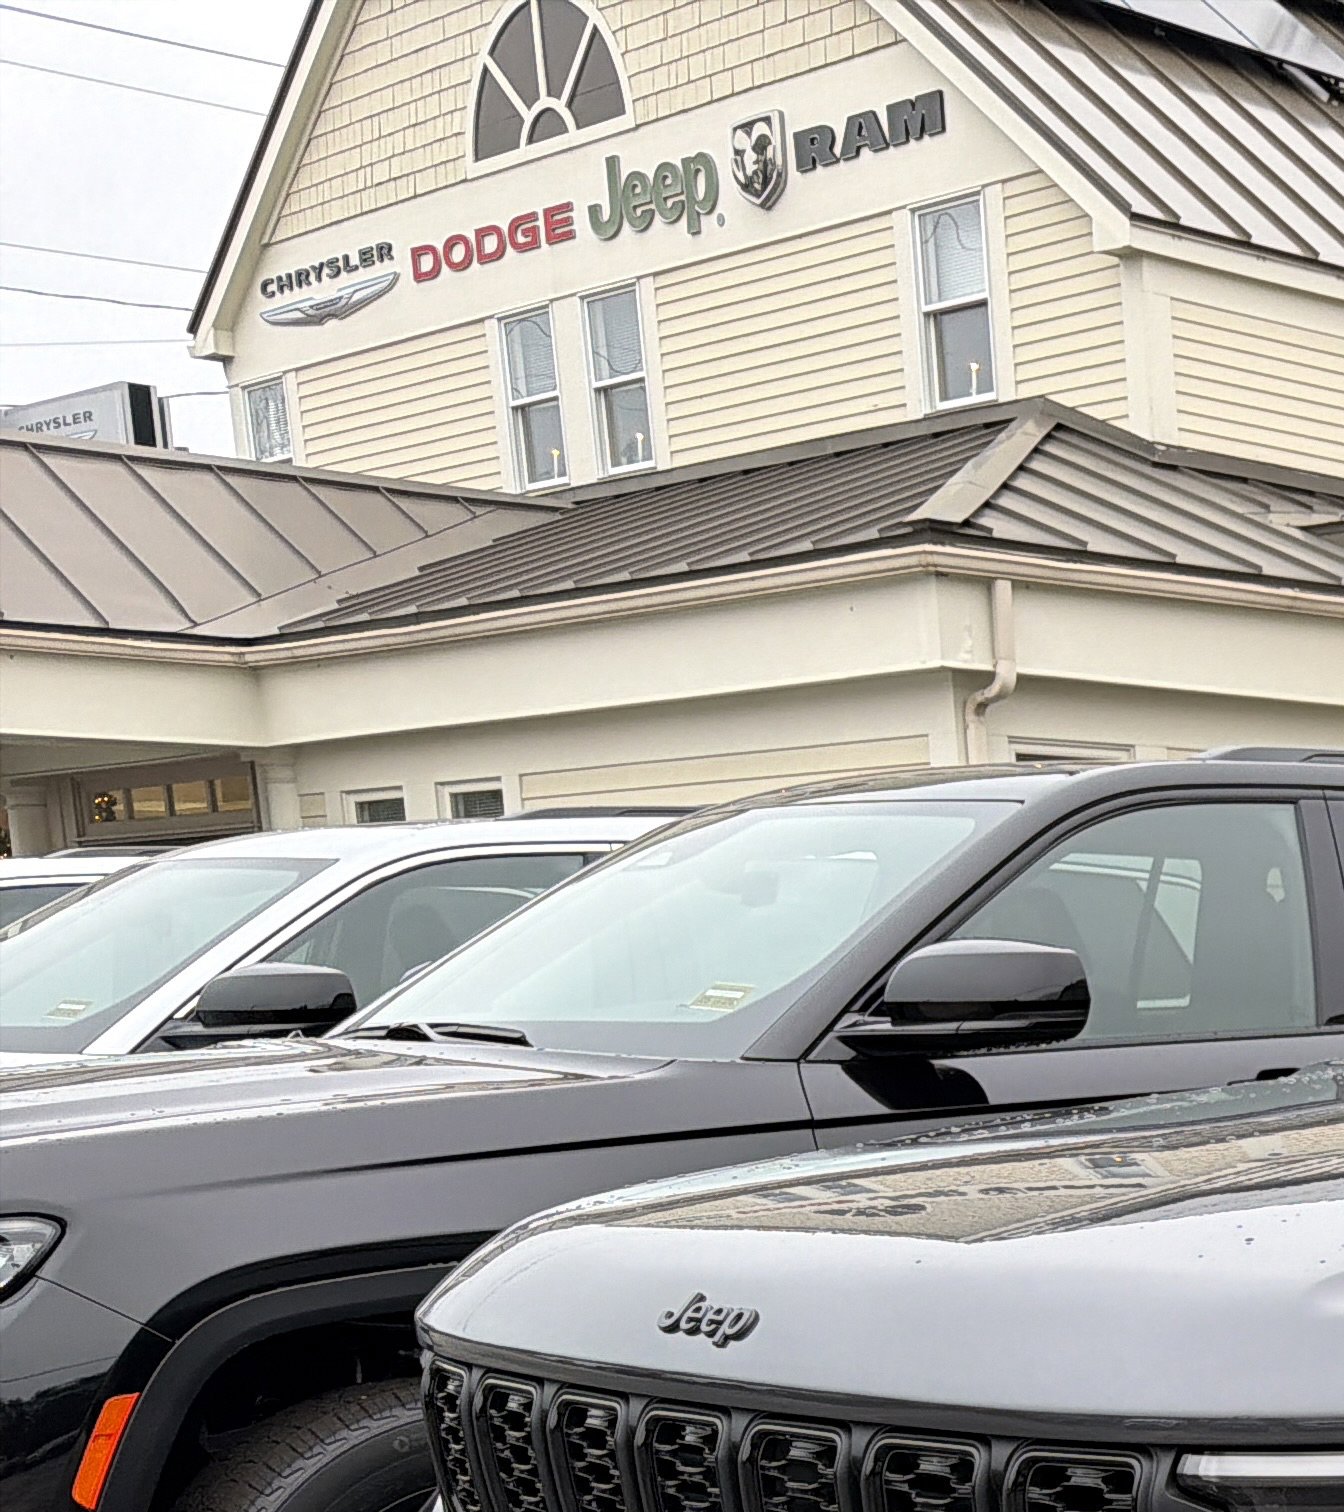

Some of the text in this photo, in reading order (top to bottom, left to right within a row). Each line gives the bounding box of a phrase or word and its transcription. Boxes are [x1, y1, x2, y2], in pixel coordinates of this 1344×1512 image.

[792, 89, 946, 173] RAM
[587, 151, 720, 240] Jeep
[260, 241, 395, 299] CHRYSLER
[410, 201, 577, 284] DODGE
[657, 1291, 761, 1349] Jeep
